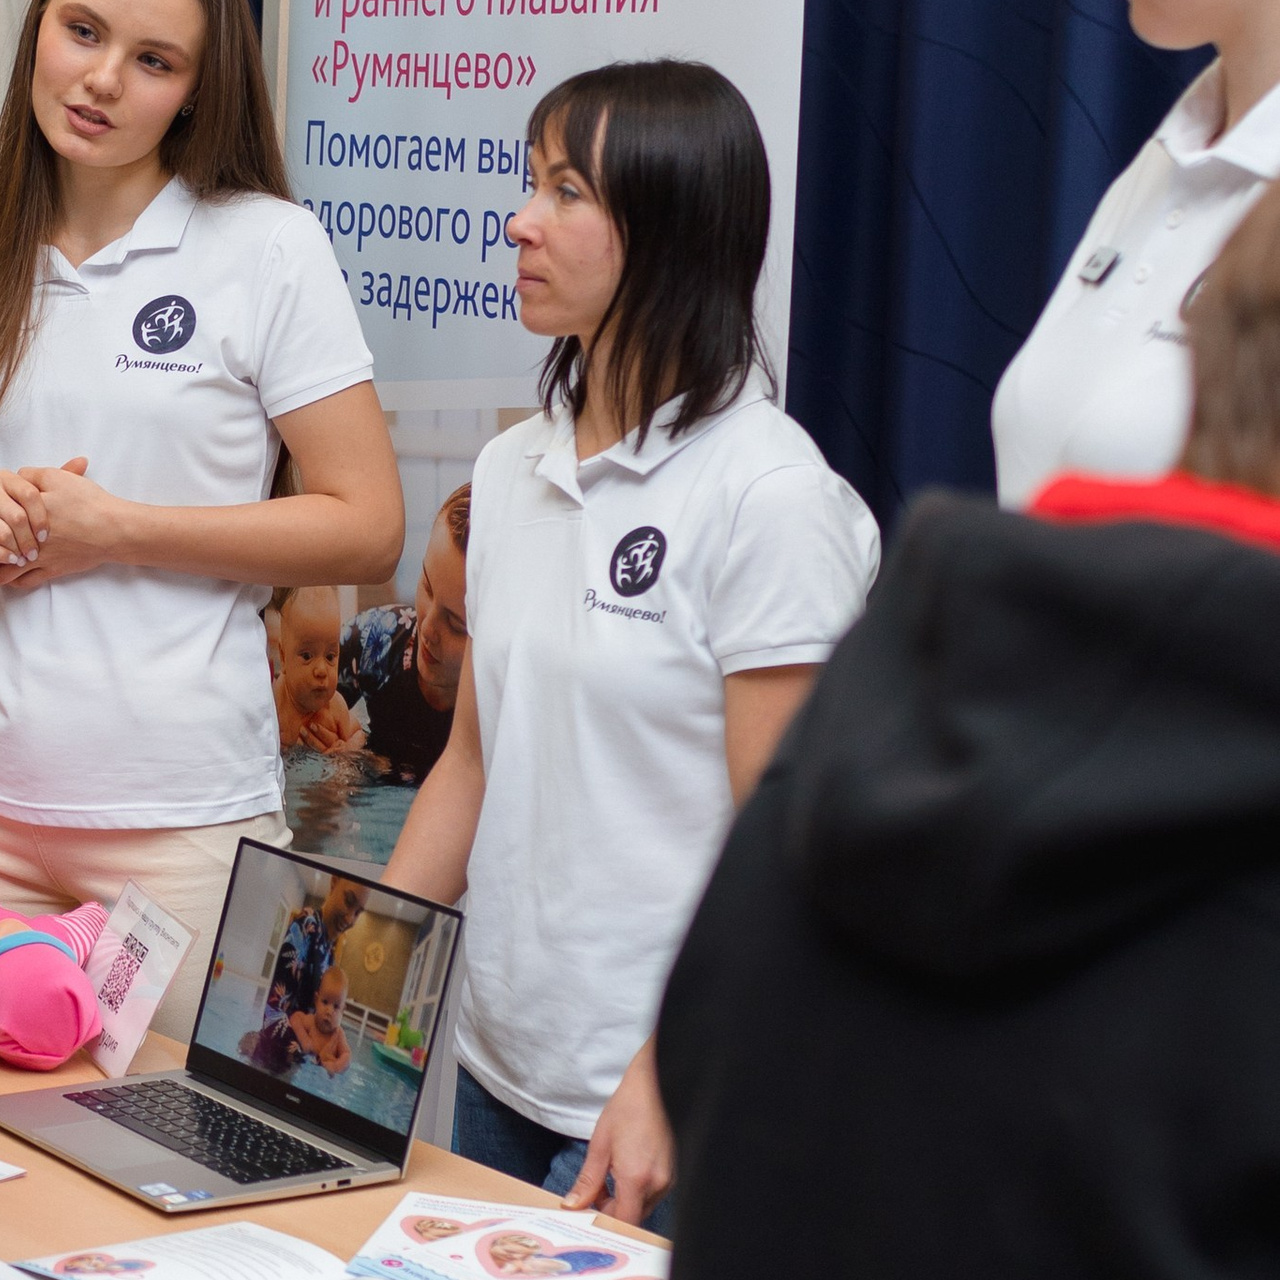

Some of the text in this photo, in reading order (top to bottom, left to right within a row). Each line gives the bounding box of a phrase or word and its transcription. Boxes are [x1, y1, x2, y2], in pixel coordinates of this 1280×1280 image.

[312, 40, 537, 103] «Румянцево»
[305, 119, 466, 173] Помогаем
[115, 353, 203, 373] Румянцево!
[583, 588, 667, 624] Румянцево!
